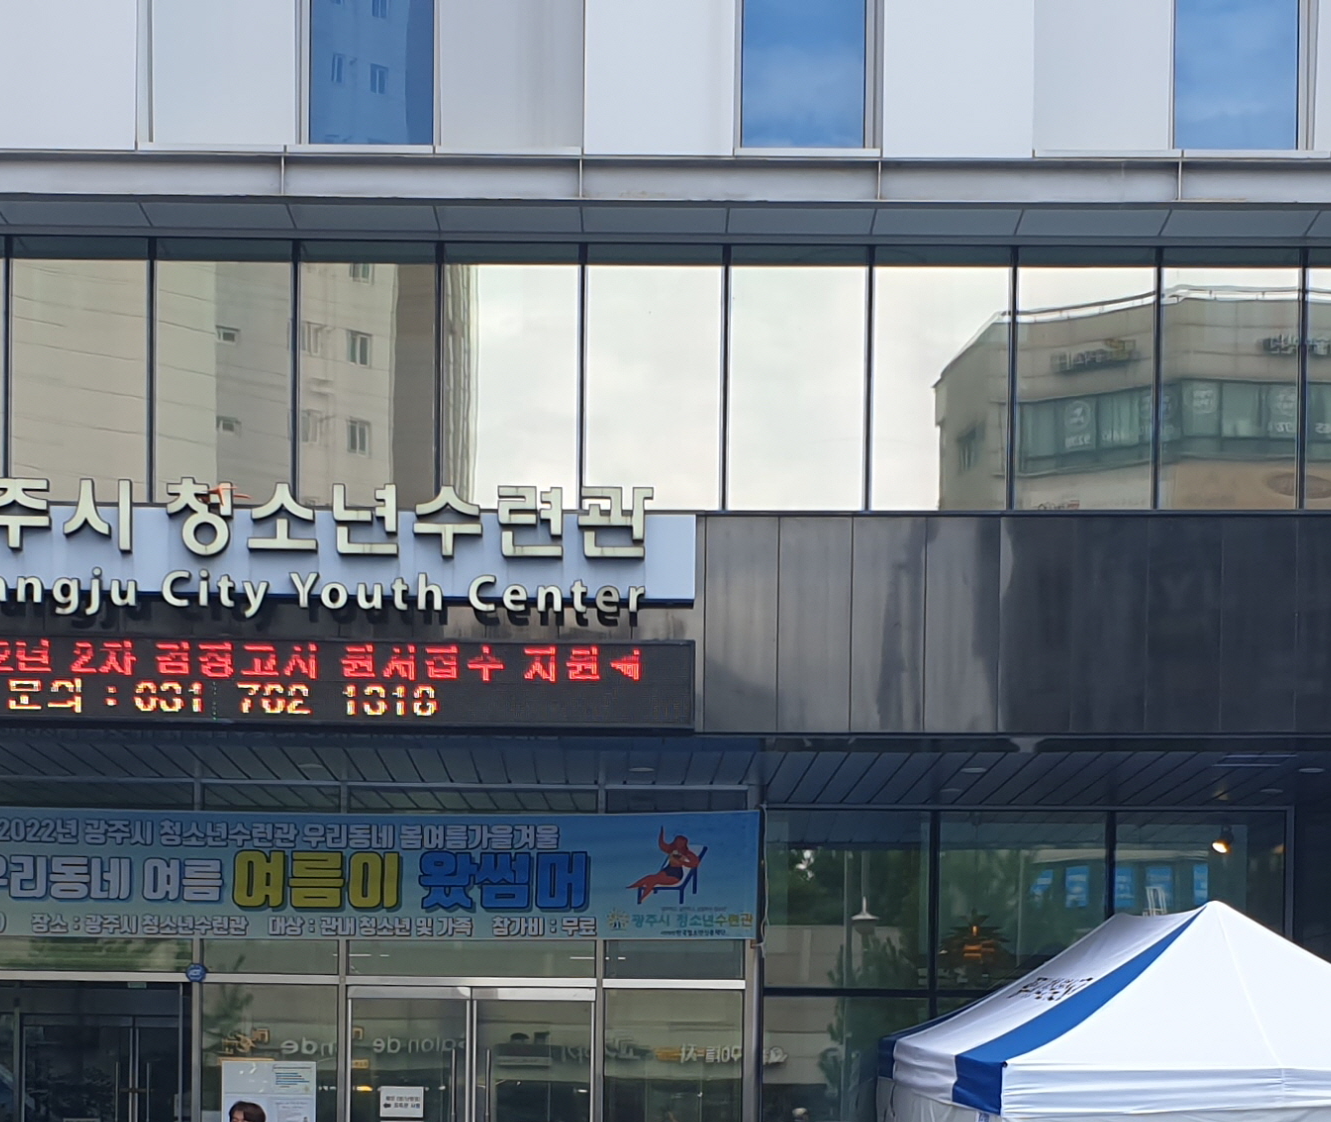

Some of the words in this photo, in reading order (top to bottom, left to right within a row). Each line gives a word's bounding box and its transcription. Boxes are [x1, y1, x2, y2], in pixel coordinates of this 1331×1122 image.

[164, 476, 655, 560] 청소년수련관
[161, 568, 269, 618] City
[290, 571, 444, 612] Youth
[468, 573, 646, 614] Center
[70, 640, 137, 675] 2차
[524, 646, 601, 682] 지원
[7, 678, 83, 713] 문의
[83, 818, 154, 846] 광주시
[159, 820, 298, 848] 청소년수련관
[303, 823, 394, 849] 우리동네
[399, 824, 560, 850] 봄여름가을겨울
[142, 856, 223, 901] 여름
[232, 850, 402, 910] 여름이
[30, 913, 69, 934] 장소
[83, 914, 137, 935] 광주시
[141, 915, 248, 935] 청소년수련관
[267, 915, 304, 937] 대상
[320, 916, 356, 937] 관내
[358, 916, 412, 937] 청소년
[415, 917, 435, 937] 및
[437, 917, 472, 937] 가족
[491, 917, 544, 938] 참가비
[560, 917, 597, 937] 무료
